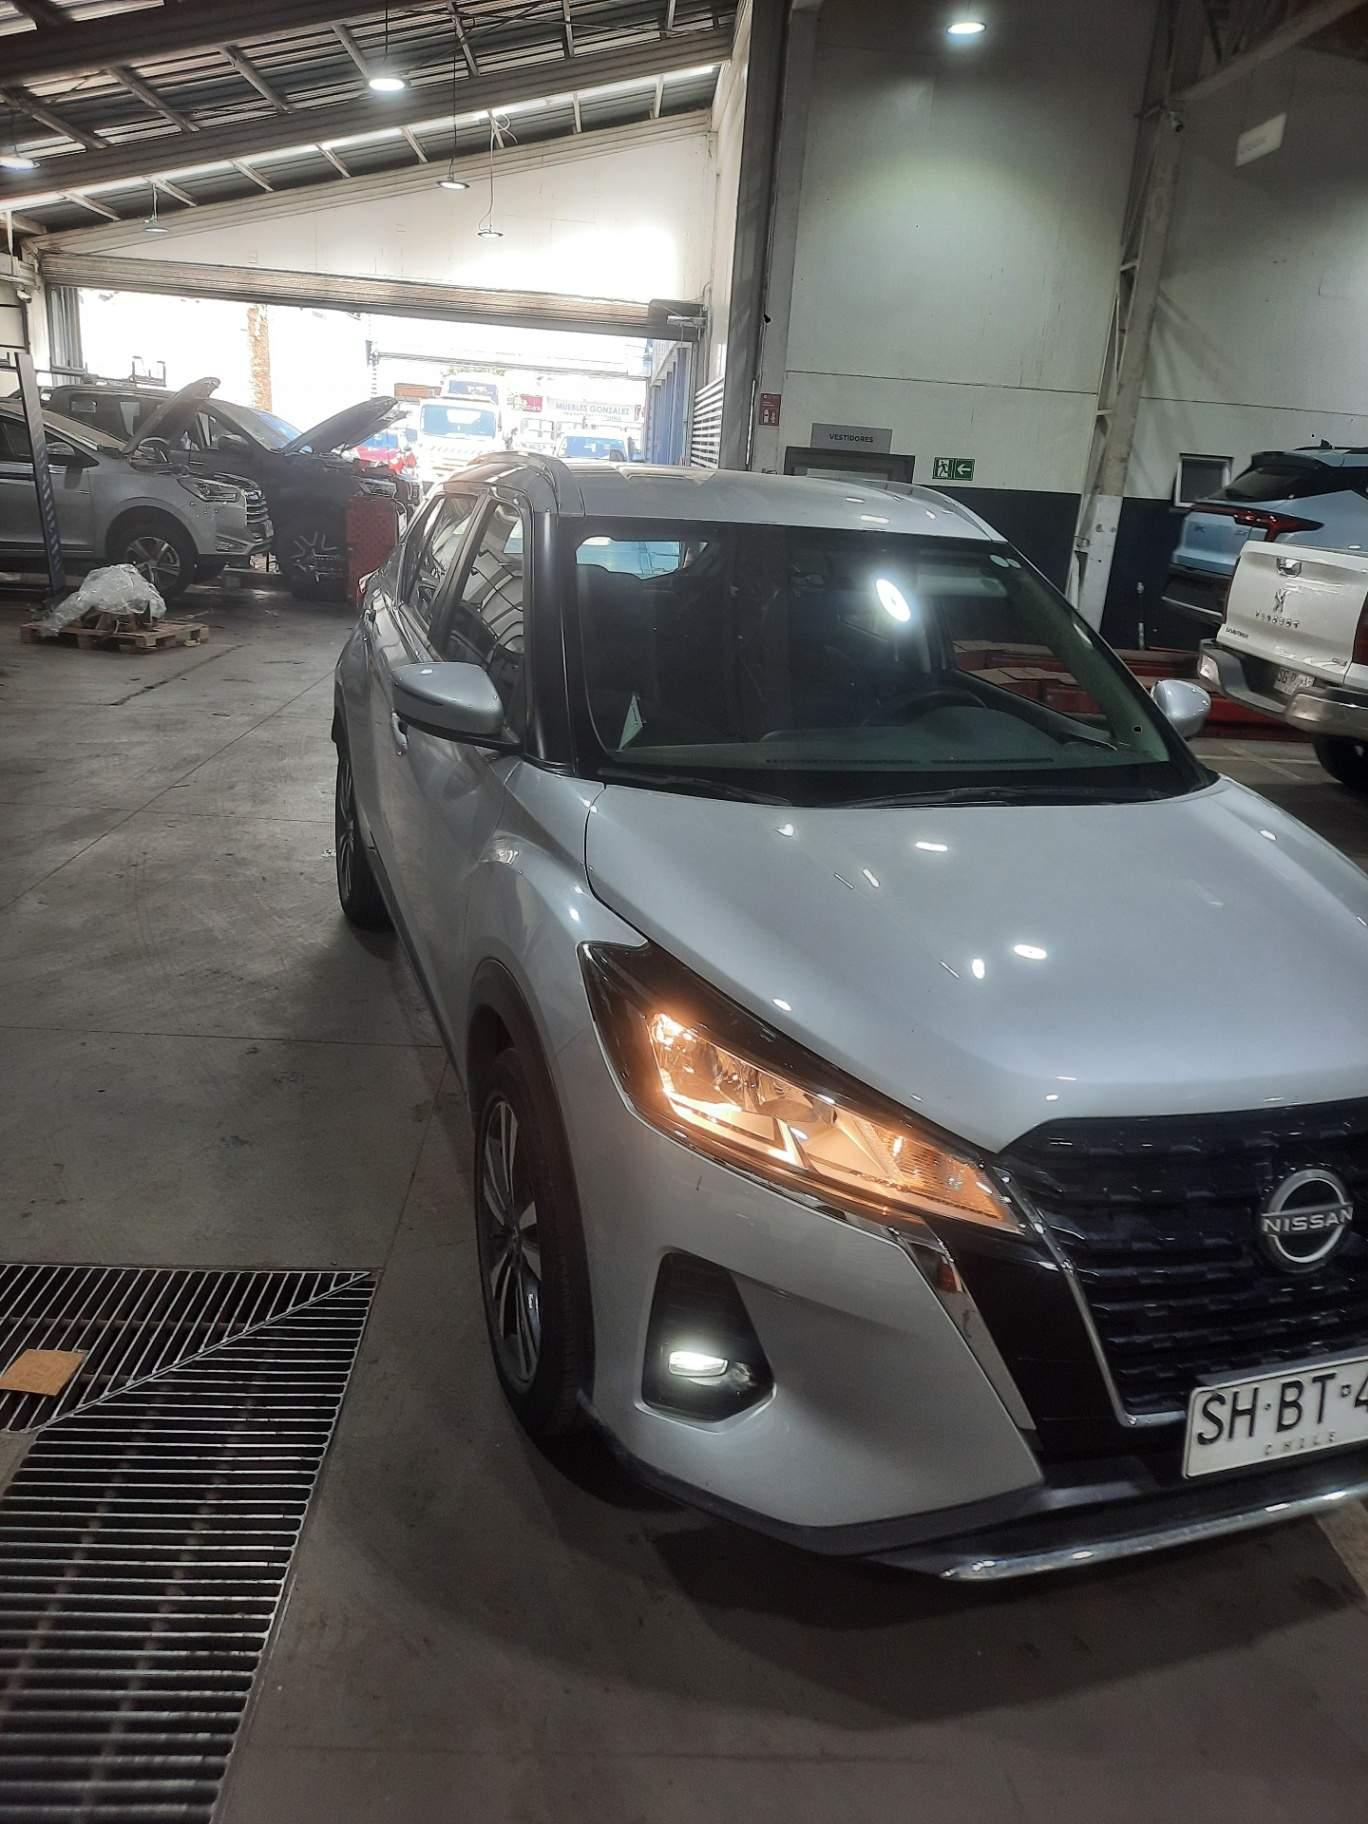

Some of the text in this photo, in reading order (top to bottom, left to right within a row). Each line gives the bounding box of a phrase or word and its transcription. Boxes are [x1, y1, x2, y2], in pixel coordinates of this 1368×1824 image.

[829, 433, 874, 443] VESTIDORES
[1263, 1206, 1353, 1232] NISSAN
[1265, 1432, 1336, 1456] CHILE
